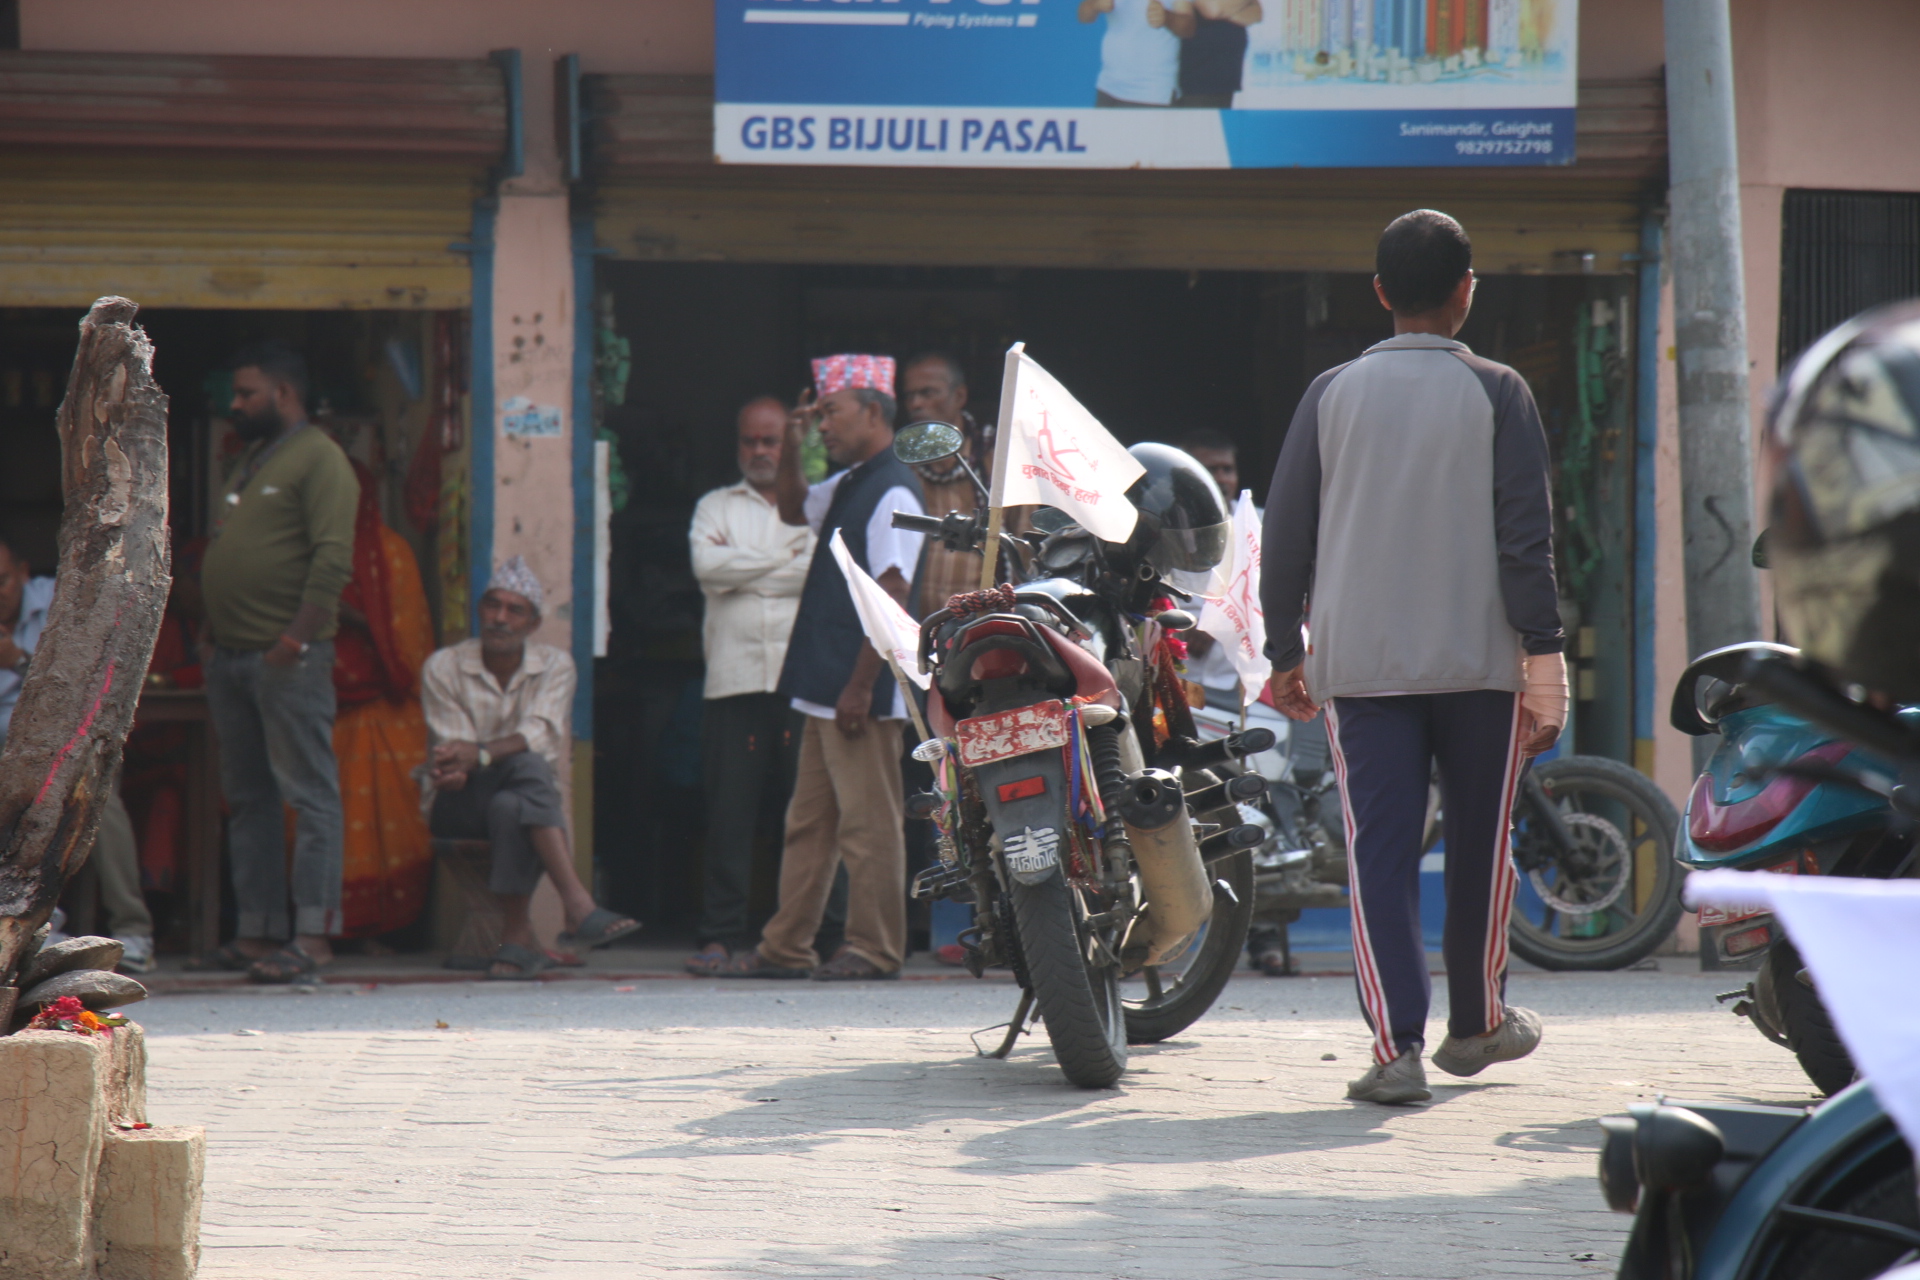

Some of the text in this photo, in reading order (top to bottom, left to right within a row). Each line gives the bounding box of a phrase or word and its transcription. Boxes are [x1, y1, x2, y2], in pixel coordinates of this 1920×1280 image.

[913, 13, 1014, 28] Piping Systems
[741, 116, 1087, 153] GBS BIJULI PASAL
[1400, 121, 1553, 138] Sanimandir, Gaighat
[1455, 140, 1553, 154] 9829752798
[1074, 486, 1102, 505] हलो
